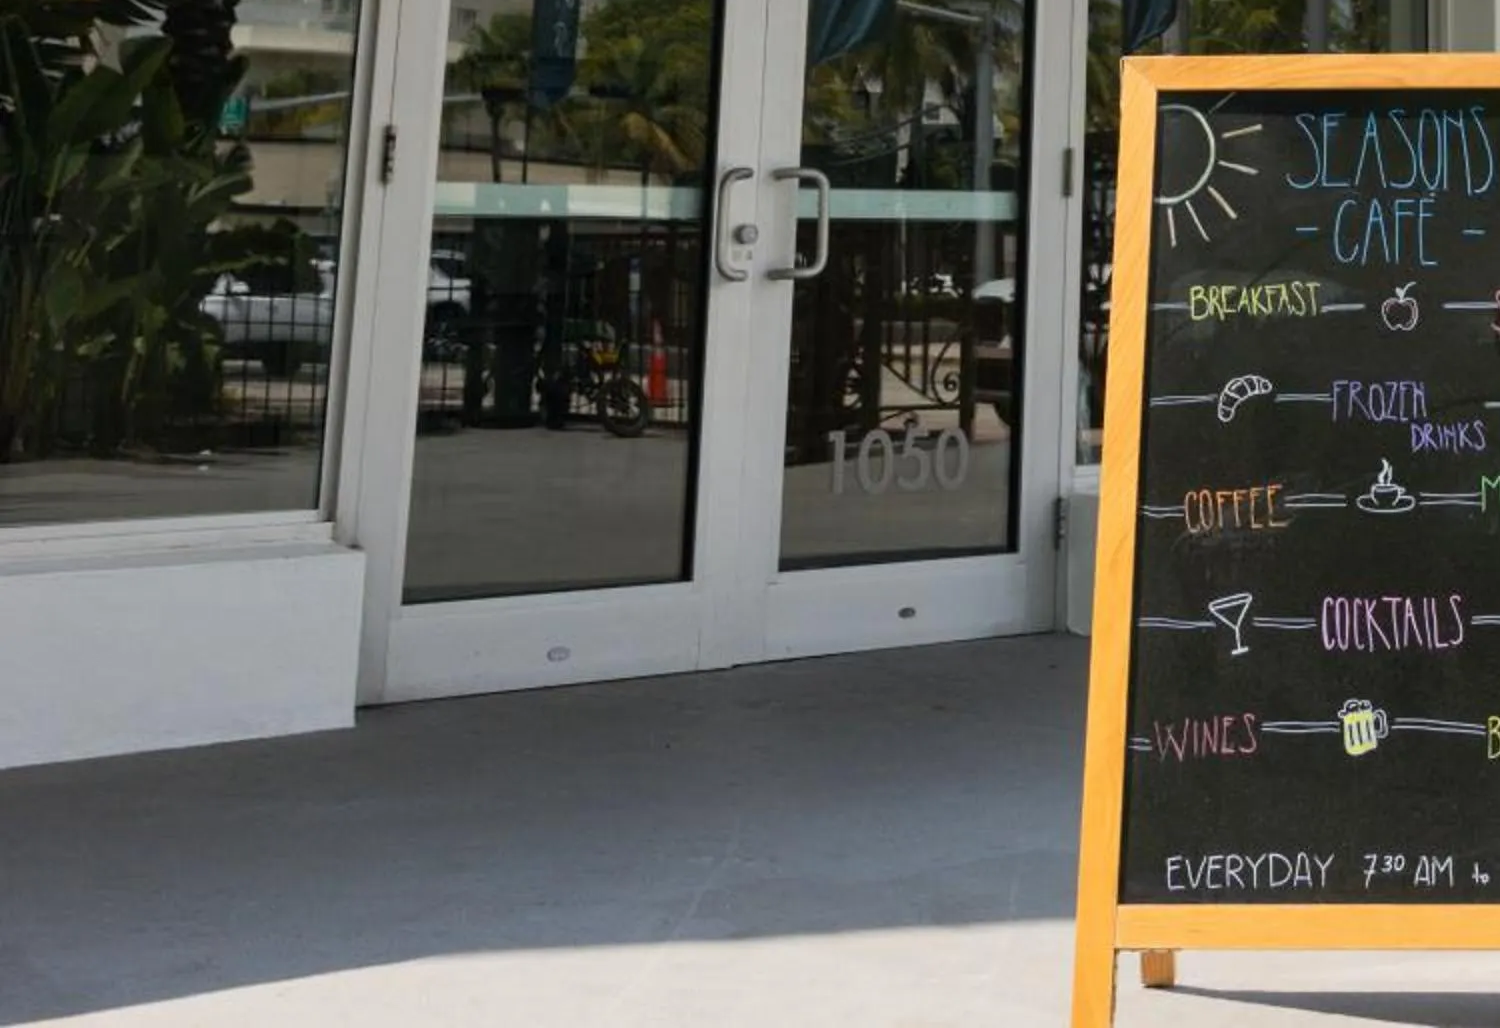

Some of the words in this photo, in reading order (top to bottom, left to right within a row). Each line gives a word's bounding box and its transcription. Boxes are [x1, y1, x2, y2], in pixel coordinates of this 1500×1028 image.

[1286, 106, 1494, 196] SEASONS
[1189, 282, 1321, 321] BREAKFAST
[1332, 380, 1426, 422] FROZEN
[828, 424, 970, 495] 1050
[1411, 421, 1487, 454] DRINKS
[1184, 484, 1290, 533] COFFEE
[1321, 594, 1464, 652] COCKTAILS
[1153, 714, 1257, 762] WINES
[1166, 852, 1335, 891] EVERYDAY
[1413, 855, 1454, 888] AM
[1471, 861, 1490, 886] to
